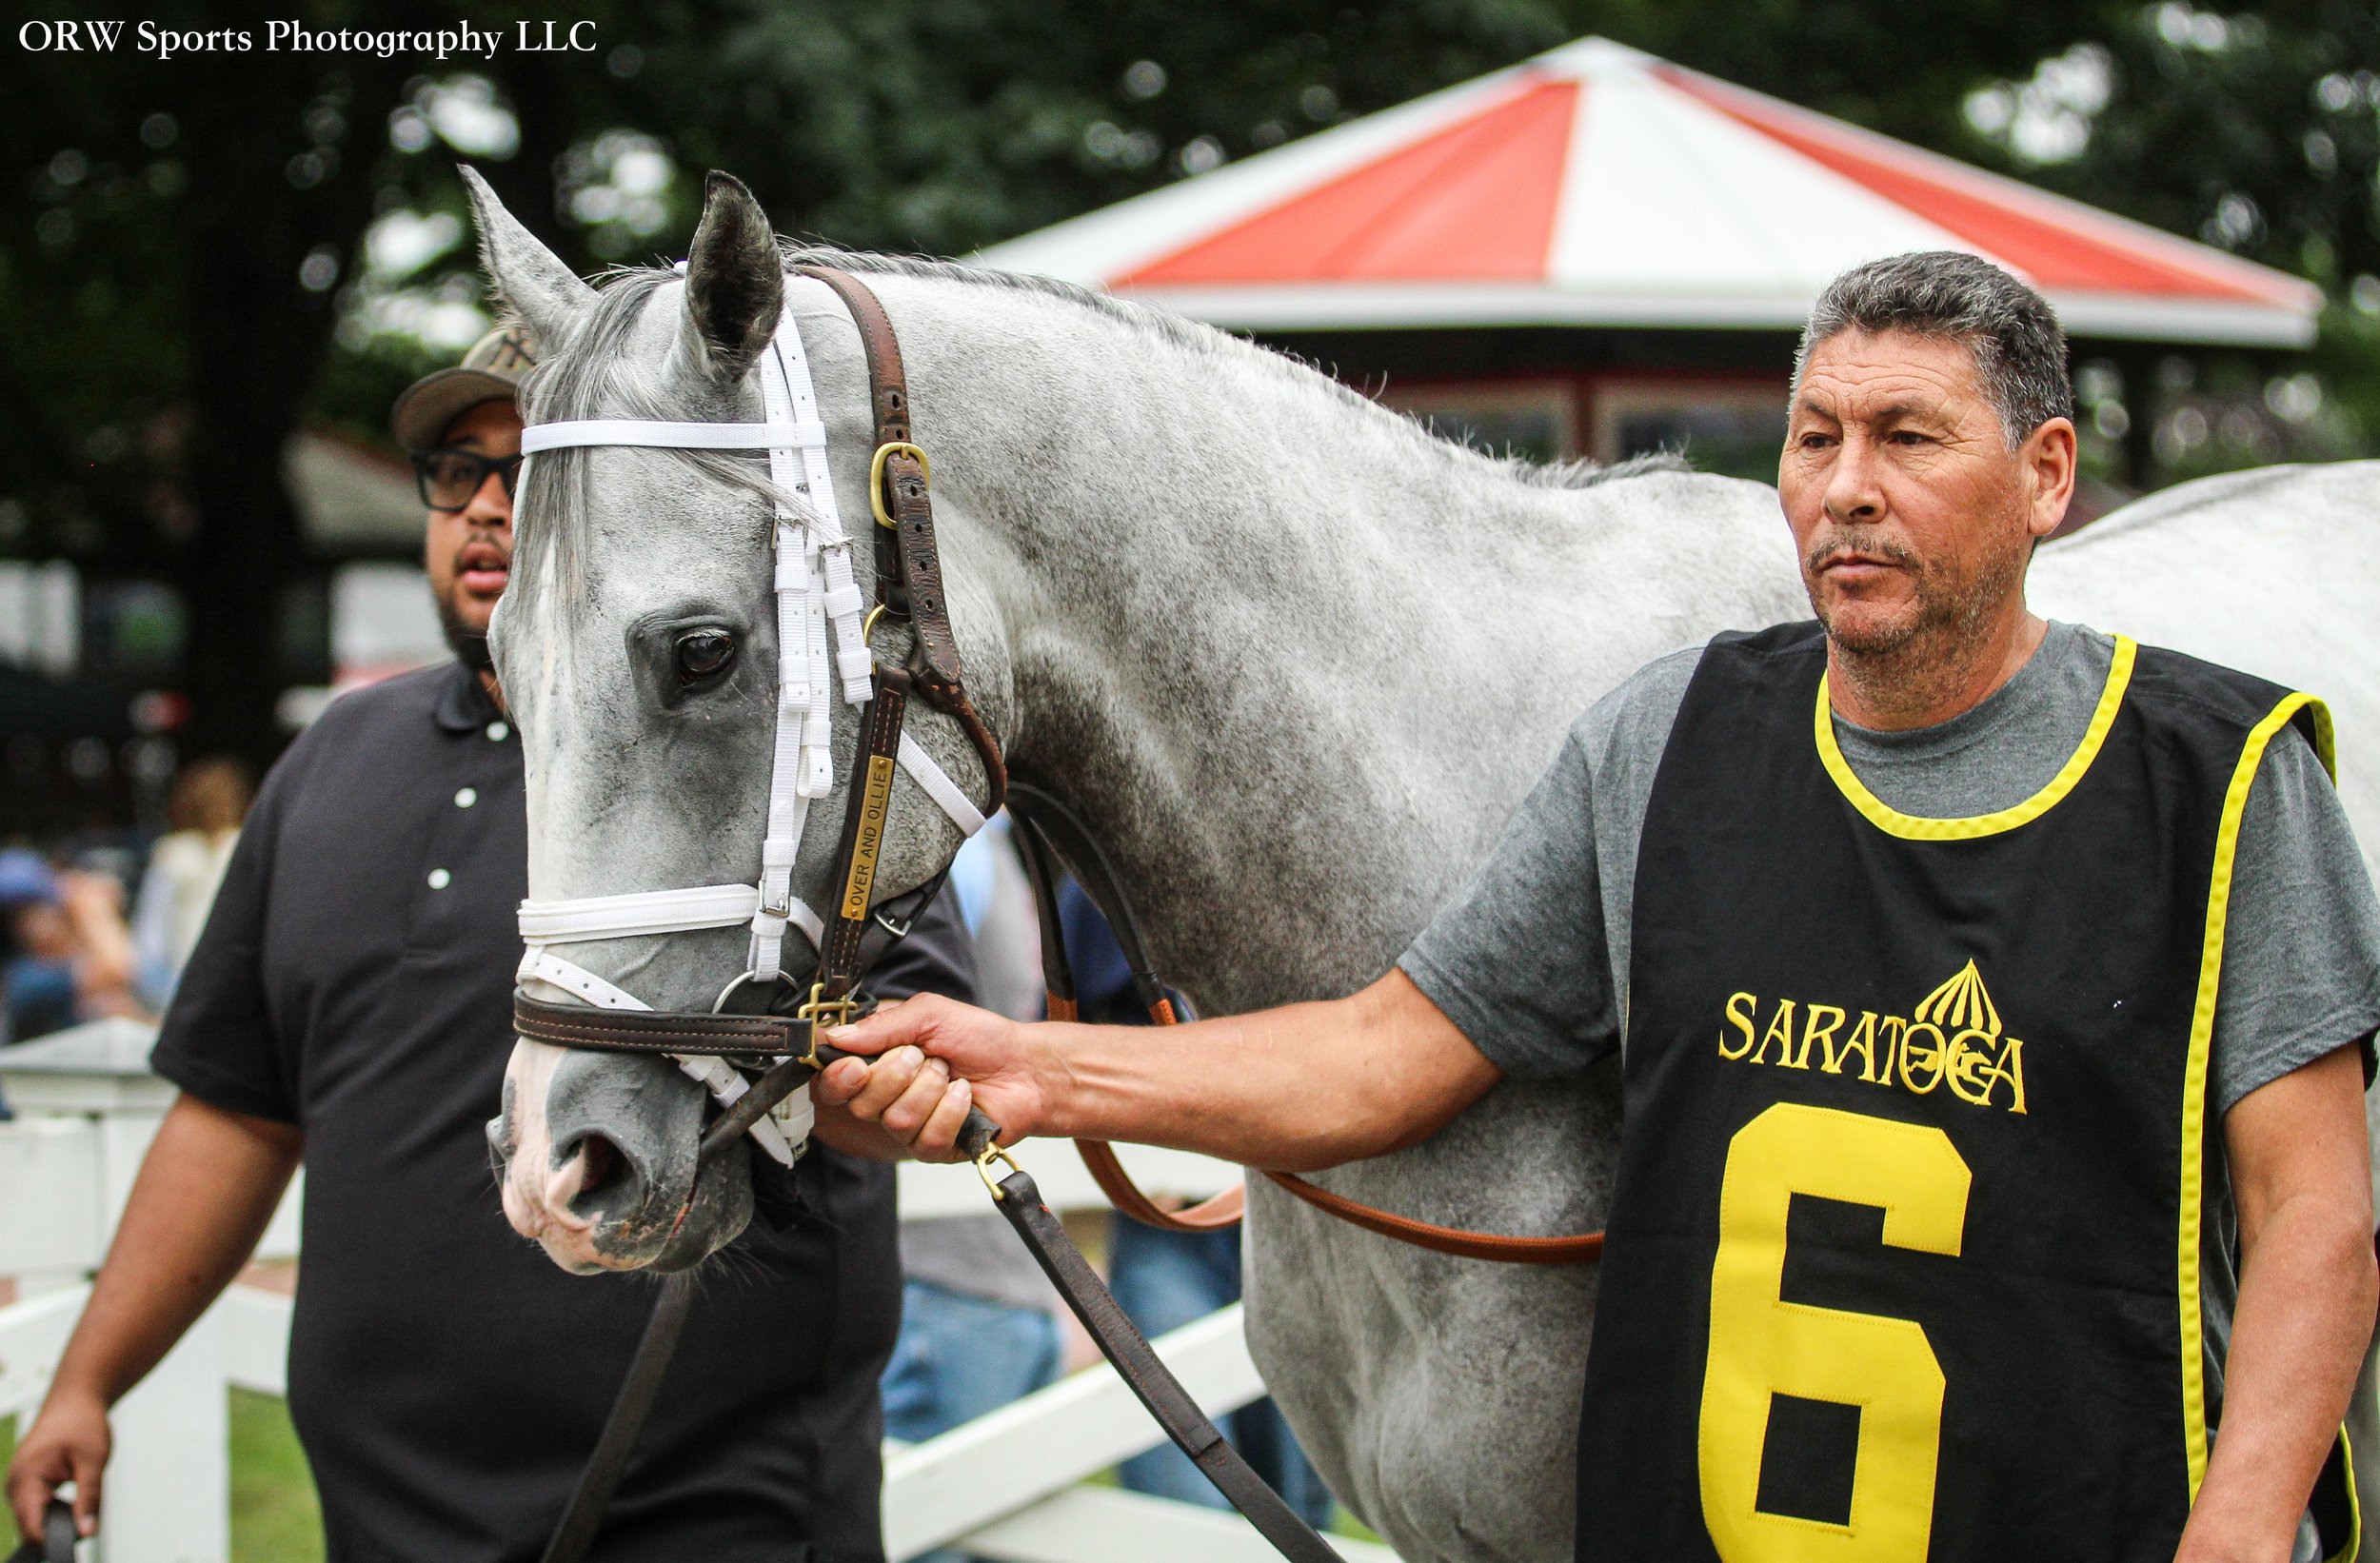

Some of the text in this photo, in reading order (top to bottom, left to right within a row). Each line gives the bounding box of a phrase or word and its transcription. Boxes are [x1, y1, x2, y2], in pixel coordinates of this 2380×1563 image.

[850, 772, 887, 906] OVER AND OLLIE
[1718, 991, 2027, 1115] SARATOGA
[1697, 1101, 1973, 1563] 6
